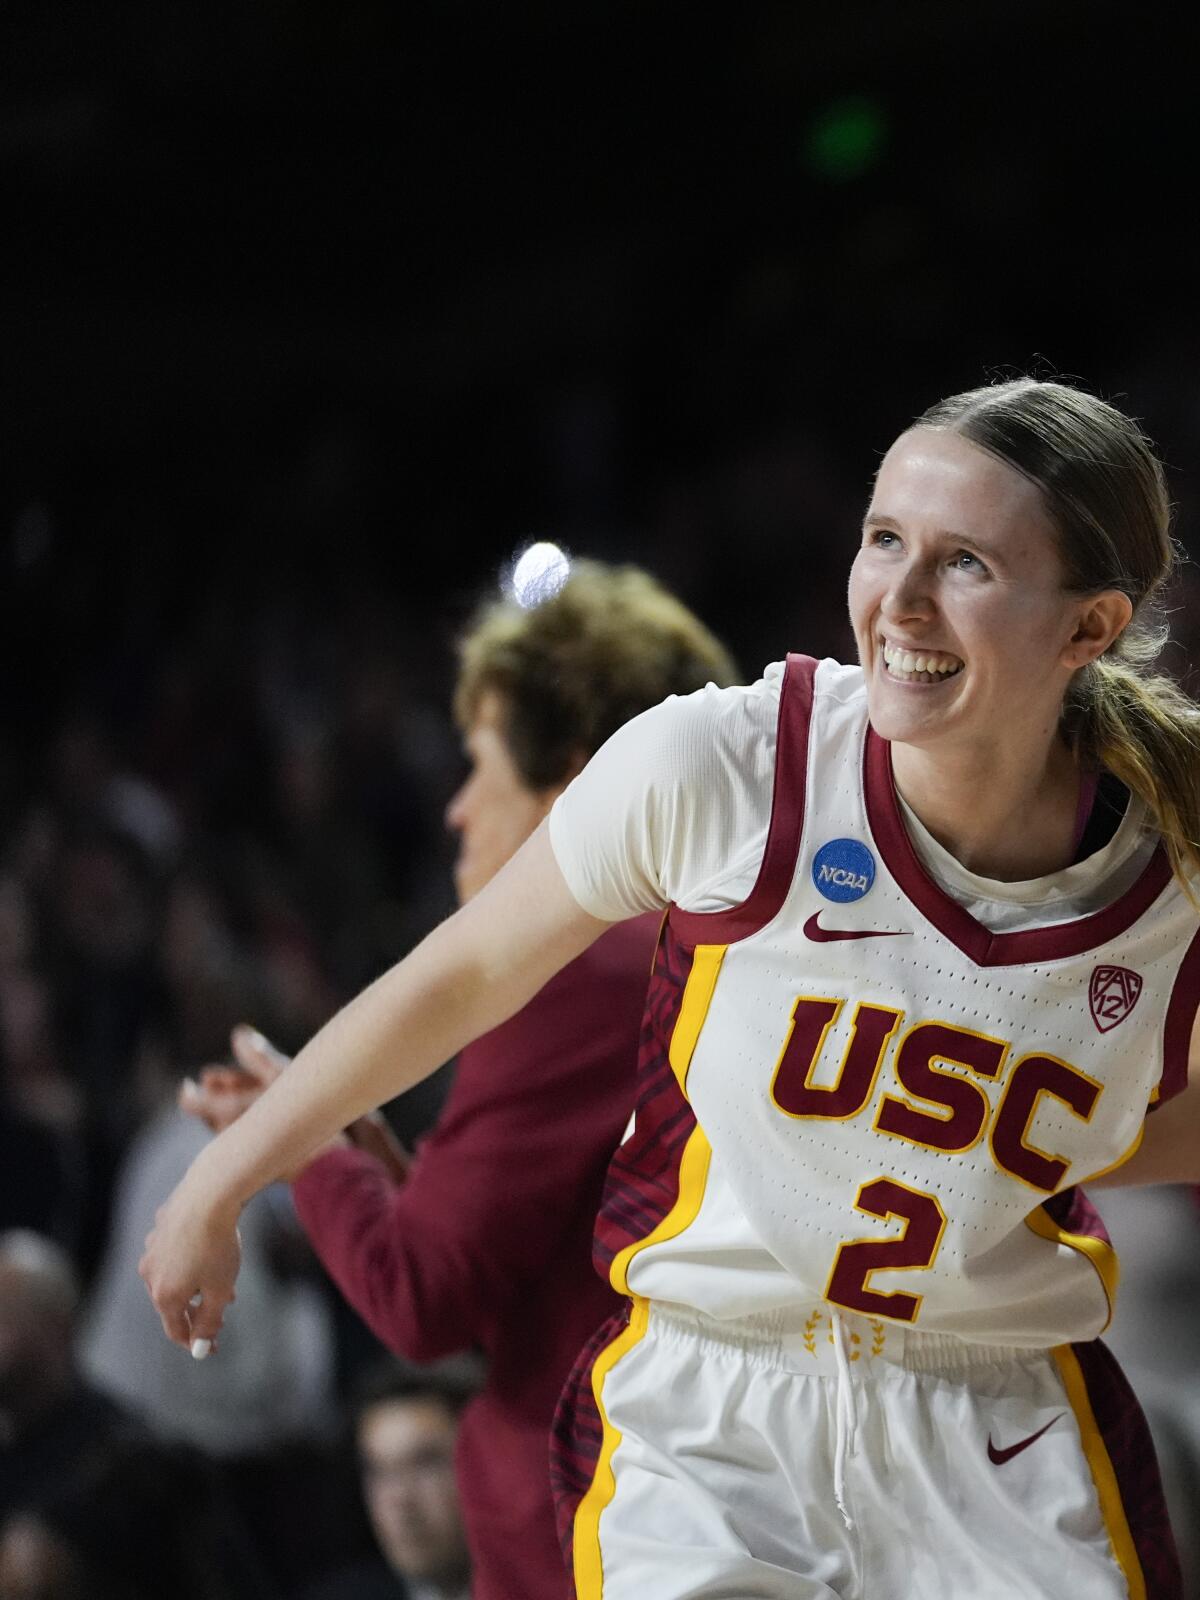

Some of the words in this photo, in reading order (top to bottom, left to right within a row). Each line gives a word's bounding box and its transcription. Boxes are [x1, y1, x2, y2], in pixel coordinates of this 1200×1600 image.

[818, 865, 868, 891] NCAA
[1094, 968, 1139, 1010] PAC
[1096, 994, 1125, 1019] 12
[770, 995, 1104, 1193] USC
[824, 1176, 947, 1323] 2
